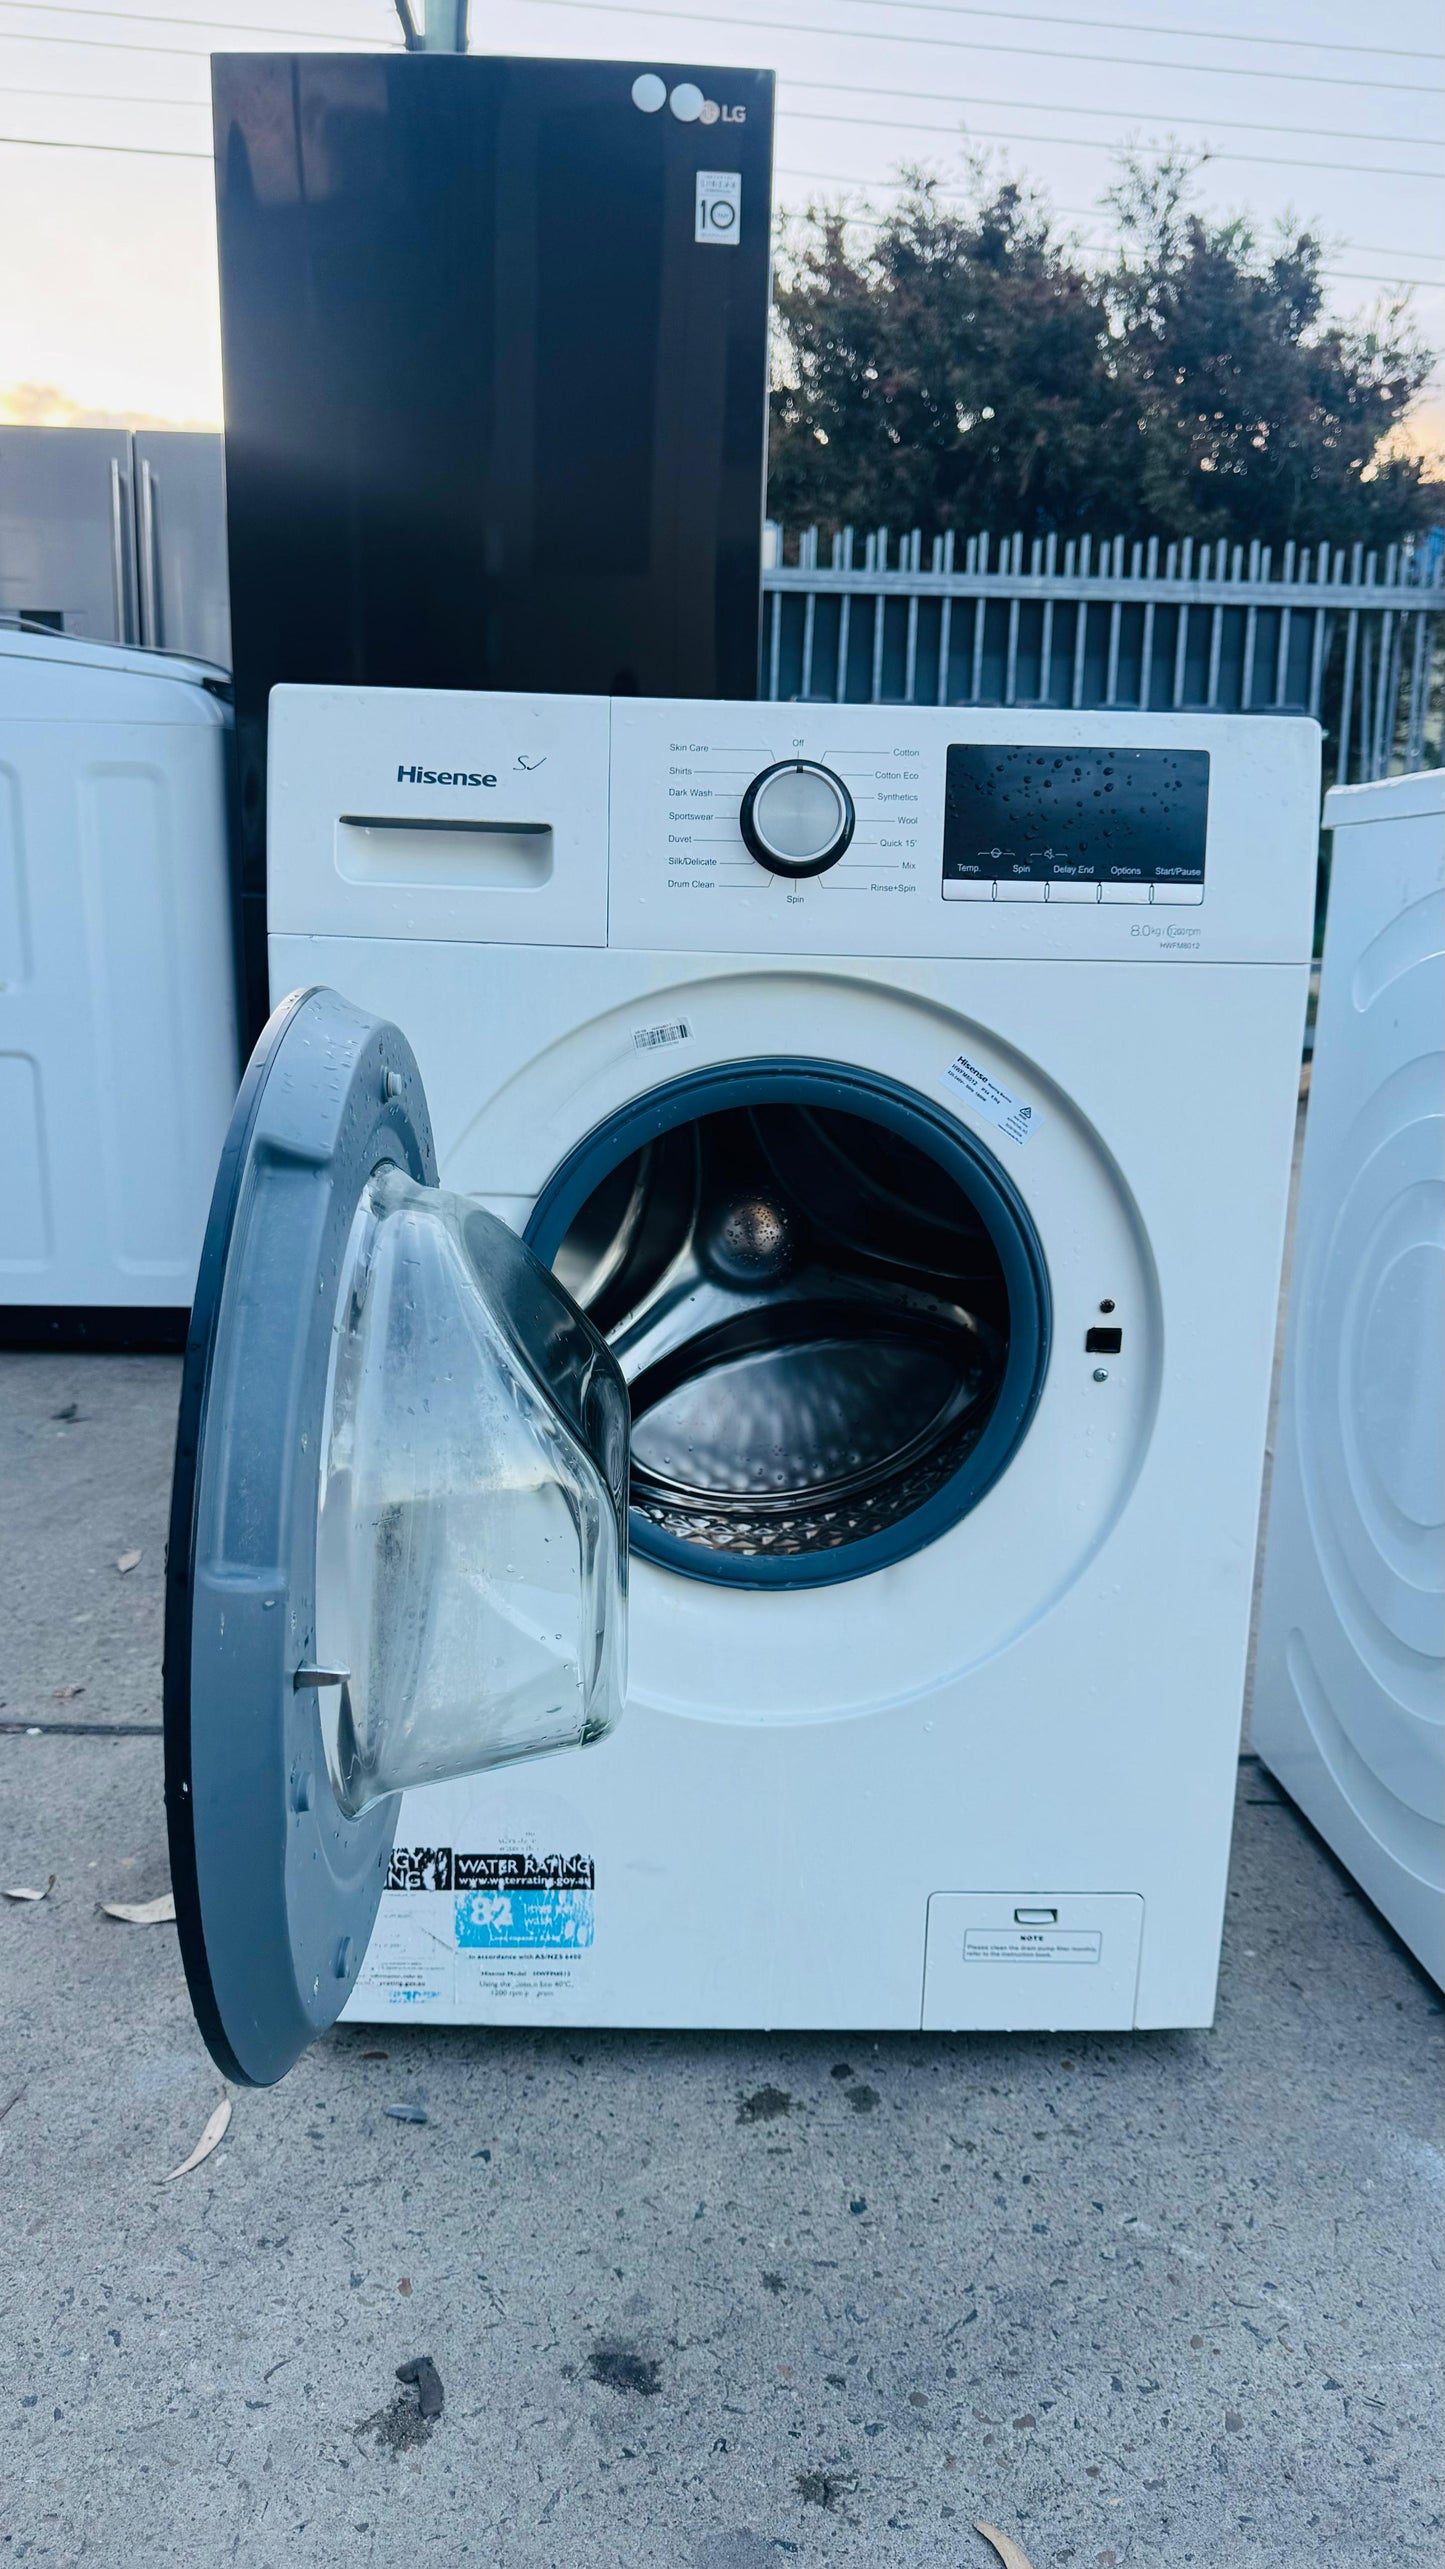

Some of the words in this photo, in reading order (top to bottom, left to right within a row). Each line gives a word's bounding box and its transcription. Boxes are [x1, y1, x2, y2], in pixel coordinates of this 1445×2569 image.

[722, 104, 746, 123] LG
[701, 199, 735, 230] 10
[792, 739, 804, 747] Off
[689, 744, 709, 752] Care
[669, 767, 692, 775] Shirts
[397, 765, 497, 787] Hisense
[875, 771, 901, 780] Cotton
[904, 772, 919, 780] Eco
[690, 789, 713, 797] Wash
[877, 793, 918, 801] Synthetics
[669, 812, 714, 821] Sportswear
[668, 835, 692, 843] Duvet
[880, 839, 903, 847] Quick
[668, 858, 717, 866] Silk/Delicate
[957, 864, 981, 872] Temp.
[1012, 865, 1031, 873] Spin
[1053, 865, 1076, 874] Delay
[1076, 866, 1094, 874] End
[1110, 866, 1141, 876] Options
[1155, 867, 1201, 876] Start/Pause
[667, 880, 690, 888] Drum
[870, 884, 916, 893] Rinse+Spin
[786, 896, 804, 904] Spin
[957, 1056, 988, 1083] Hisense
[459, 1859, 518, 1874] WATER
[524, 1859, 589, 1874] RATING
[471, 1897, 513, 1925] 82
